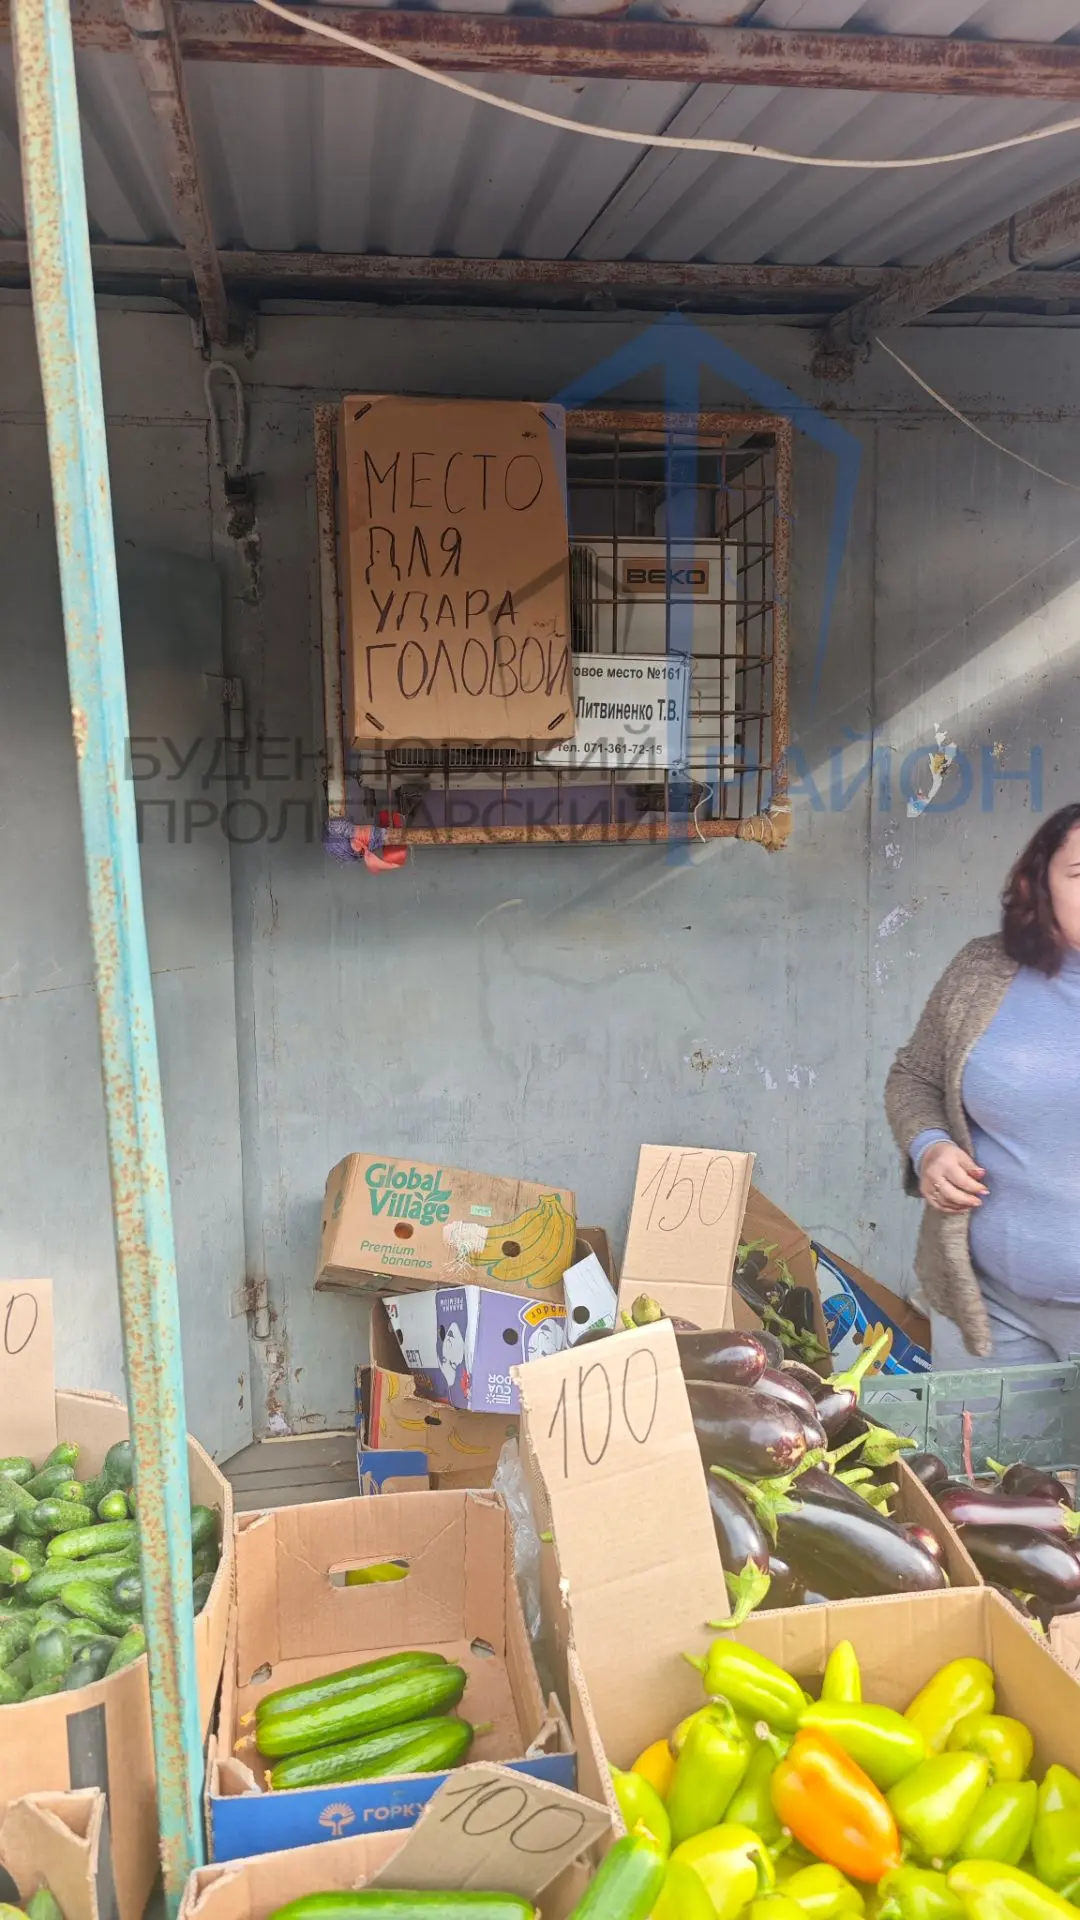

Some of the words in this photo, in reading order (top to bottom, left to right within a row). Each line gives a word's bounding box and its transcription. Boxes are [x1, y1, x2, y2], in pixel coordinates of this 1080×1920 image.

[364, 450, 544, 518] МЕСТО
[365, 525, 463, 584] ДЛЯ
[626, 568, 706, 585] BEKO
[369, 589, 519, 634] УДАРА
[365, 632, 569, 703] ГОЛОВОЙ
[572, 666, 603, 678] овое
[606, 667, 643, 679] место
[647, 666, 681, 681] №161
[576, 696, 654, 721] Литвиненко
[657, 698, 680, 722] Т.В.
[558, 743, 580, 752] тел.
[583, 742, 663, 755] 071-361-72-15
[365, 1162, 443, 1192] Global
[641, 1151, 735, 1232] 150
[369, 1188, 451, 1226] Village
[360, 1240, 415, 1256] Premium
[380, 1253, 433, 1269] bananas
[548, 1348, 658, 1479] 100
[440, 1778, 586, 1854] 100
